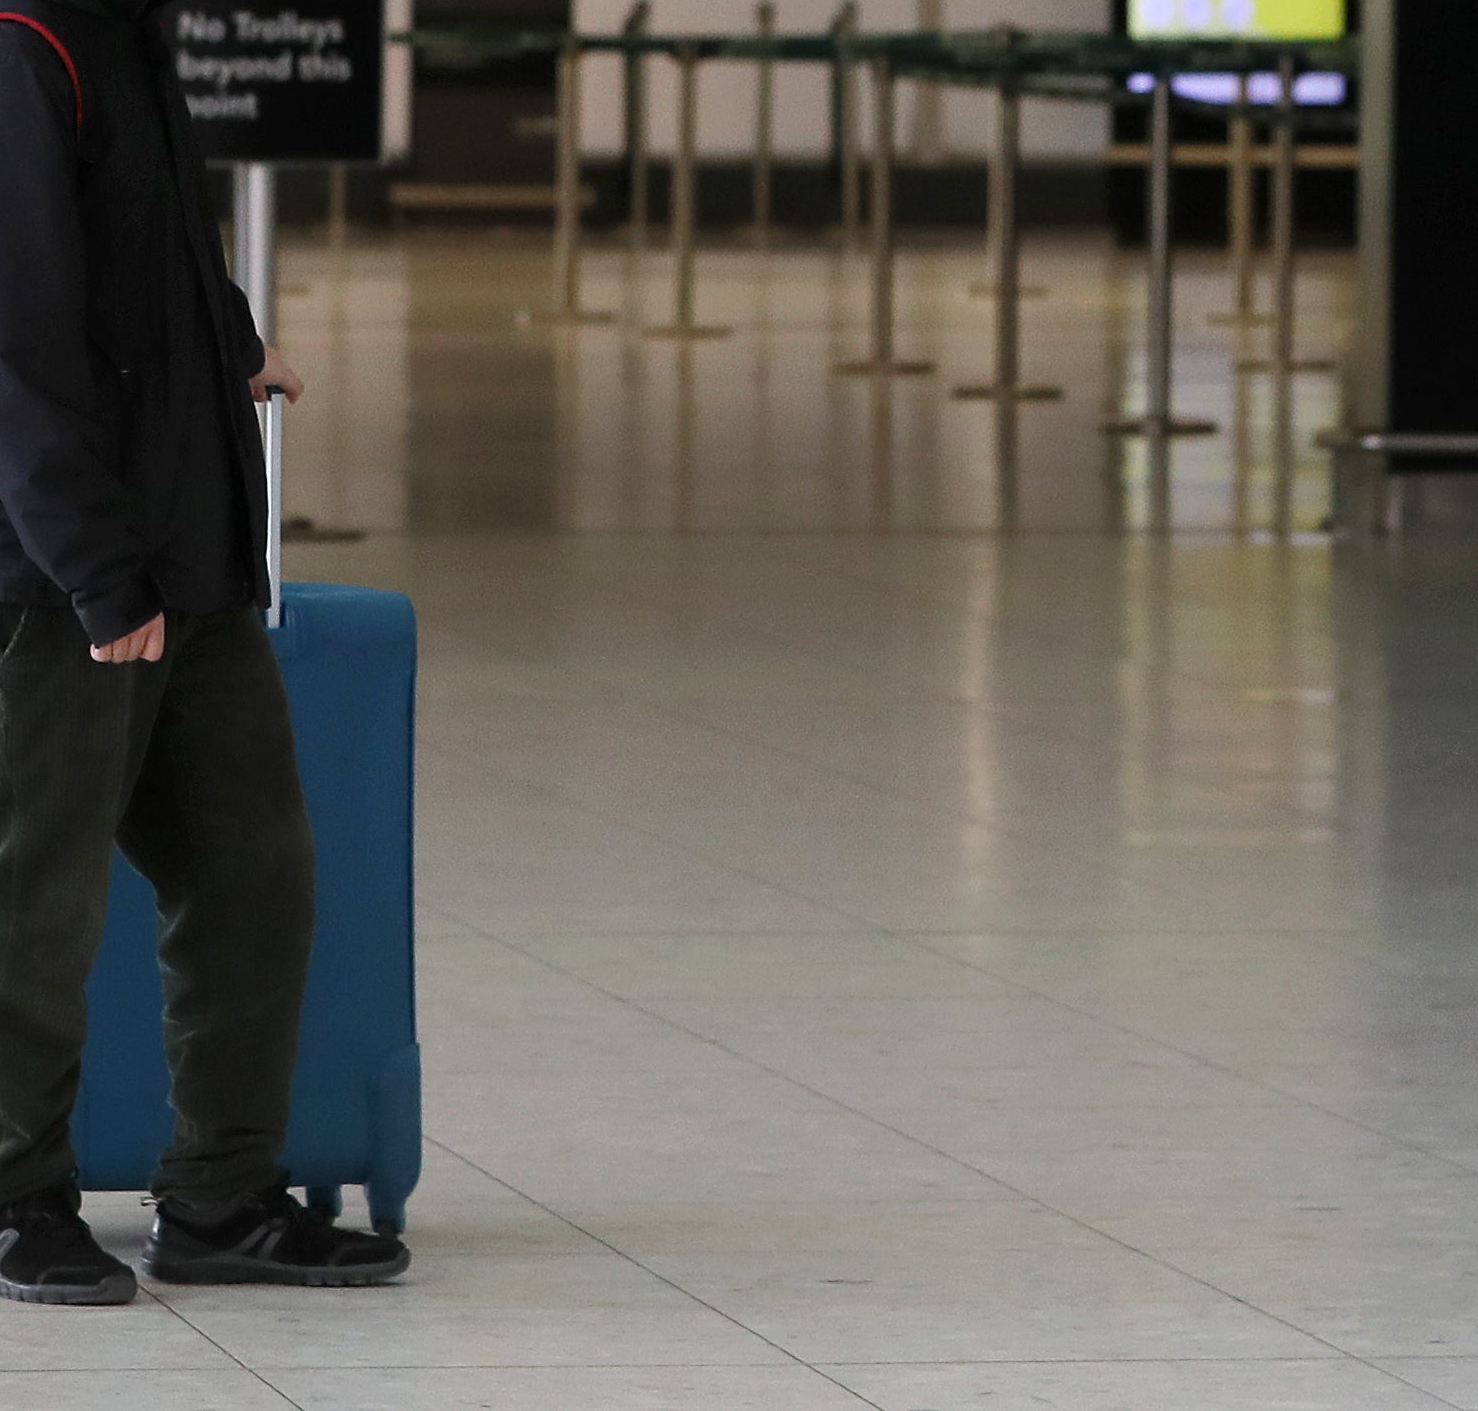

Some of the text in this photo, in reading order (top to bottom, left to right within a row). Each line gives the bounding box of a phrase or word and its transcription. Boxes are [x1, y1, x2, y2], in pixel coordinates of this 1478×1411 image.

[177, 9, 345, 55] No Trolleys
[175, 48, 352, 88] beyond this
